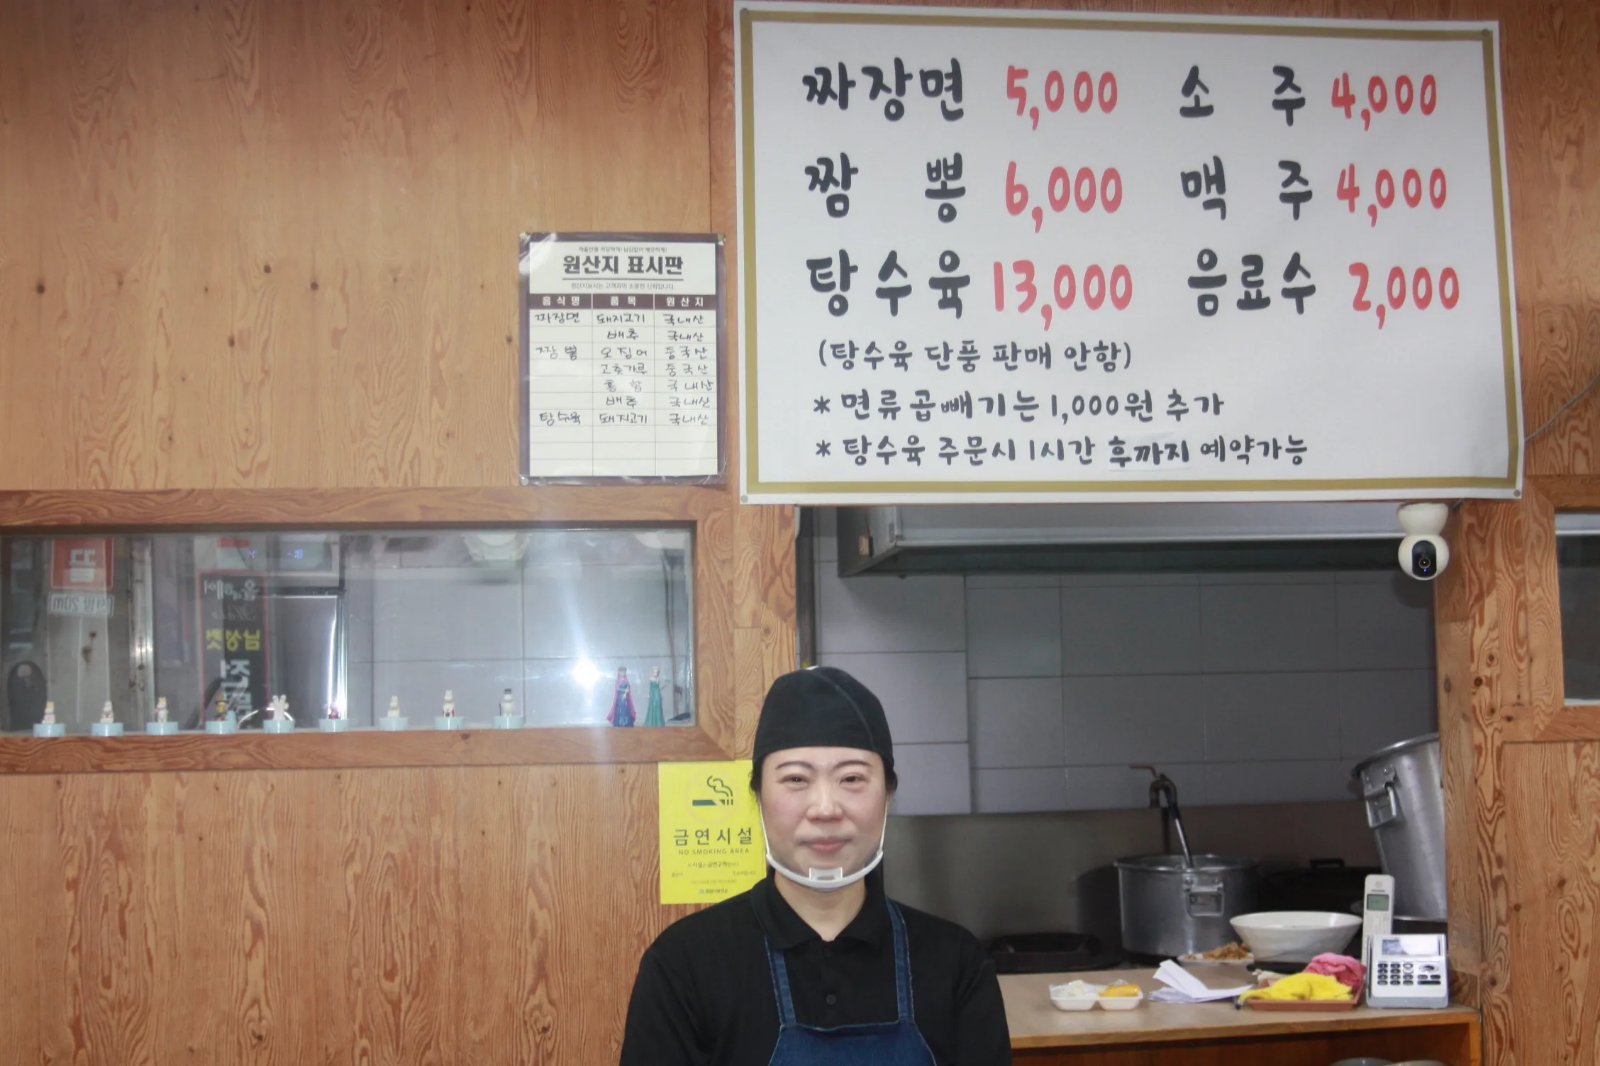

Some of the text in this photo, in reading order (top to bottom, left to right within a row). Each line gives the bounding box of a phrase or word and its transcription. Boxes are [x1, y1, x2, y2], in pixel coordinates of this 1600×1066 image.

[802, 57, 1117, 130] 짜장면 5,000
[1332, 72, 1436, 130] 4,000
[1006, 161, 1122, 233] 6,000
[1337, 163, 1446, 227] 4,000
[564, 256, 683, 274] 원산지 표시판
[806, 249, 1132, 331] 탕수육 13,000
[1188, 249, 1459, 329] 음료수 2,000
[543, 296, 580, 307] 음식명
[666, 296, 704, 307] 원산지
[596, 313, 645, 324] 돼지고기
[663, 313, 703, 327] 국내산
[606, 327, 639, 341] 배추
[668, 330, 704, 342] 국내산
[600, 347, 648, 360] 오징어
[819, 340, 1131, 373] (탕수육 단품 판매 안함)
[668, 379, 714, 392] 국내산
[605, 395, 637, 409] 배추
[669, 396, 711, 409] 국내산
[1052, 390, 1153, 424] 1,000원
[1167, 389, 1224, 422] 추가
[599, 412, 648, 424] 돼지고기
[668, 412, 708, 427] 국내산
[843, 435, 1307, 467] 탕수육 주문시 1시간 후까지 예약가능
[673, 827, 753, 846] 금연시설
